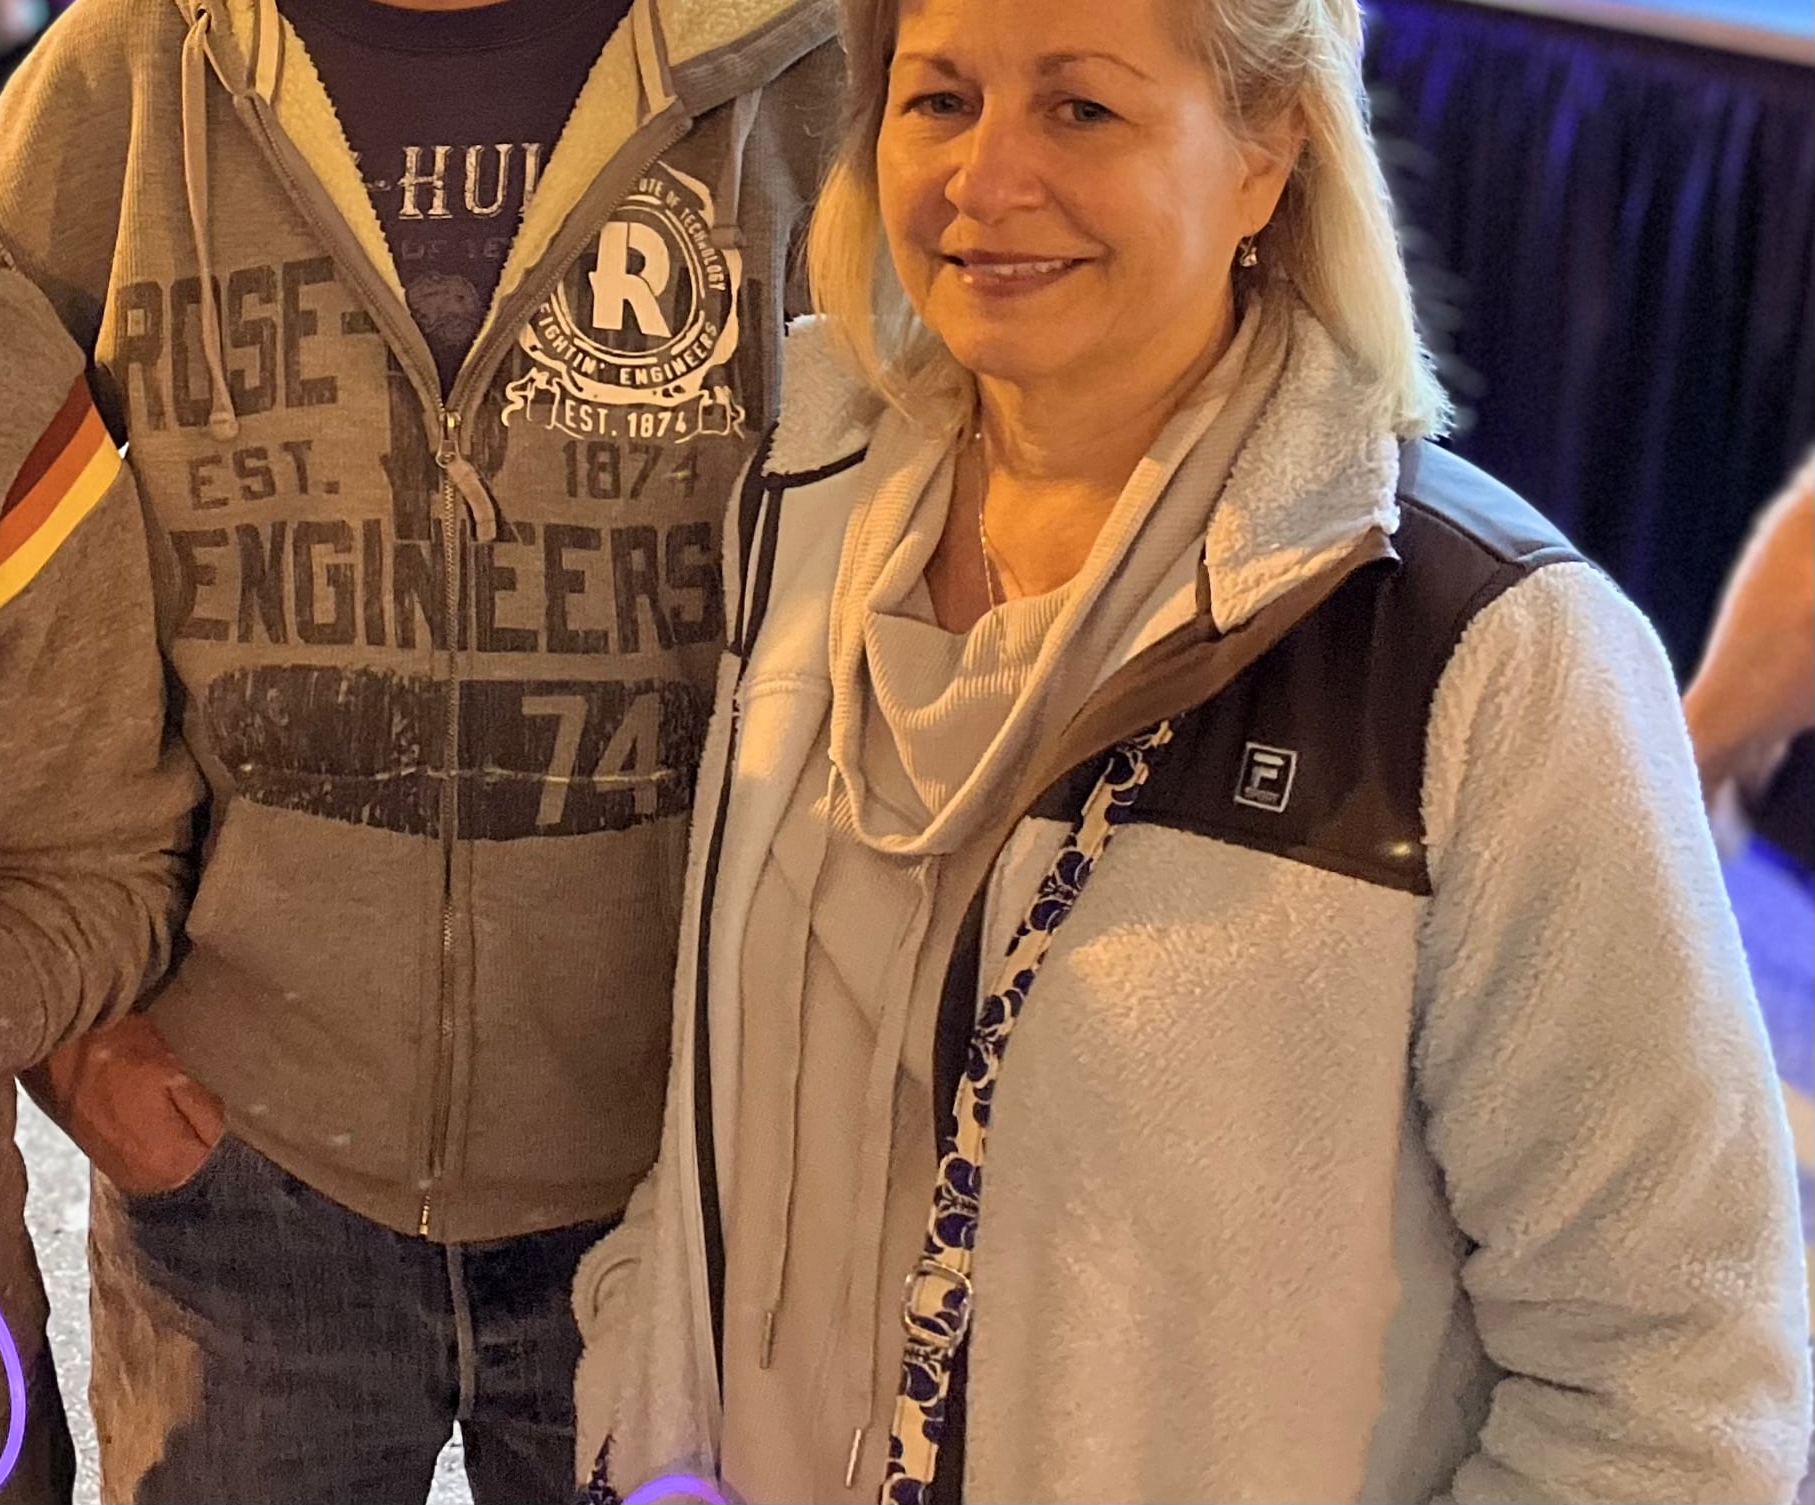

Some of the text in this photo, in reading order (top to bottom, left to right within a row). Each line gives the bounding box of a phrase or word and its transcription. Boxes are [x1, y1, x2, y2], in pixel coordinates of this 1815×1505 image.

[664, 189, 681, 207] OF
[587, 220, 673, 339] R
[618, 321, 719, 386] ENGINEERS
[563, 399, 688, 440] EST. 1874
[188, 439, 340, 511] EST.
[170, 518, 728, 654] ENGINEERS
[521, 694, 661, 827] 74
